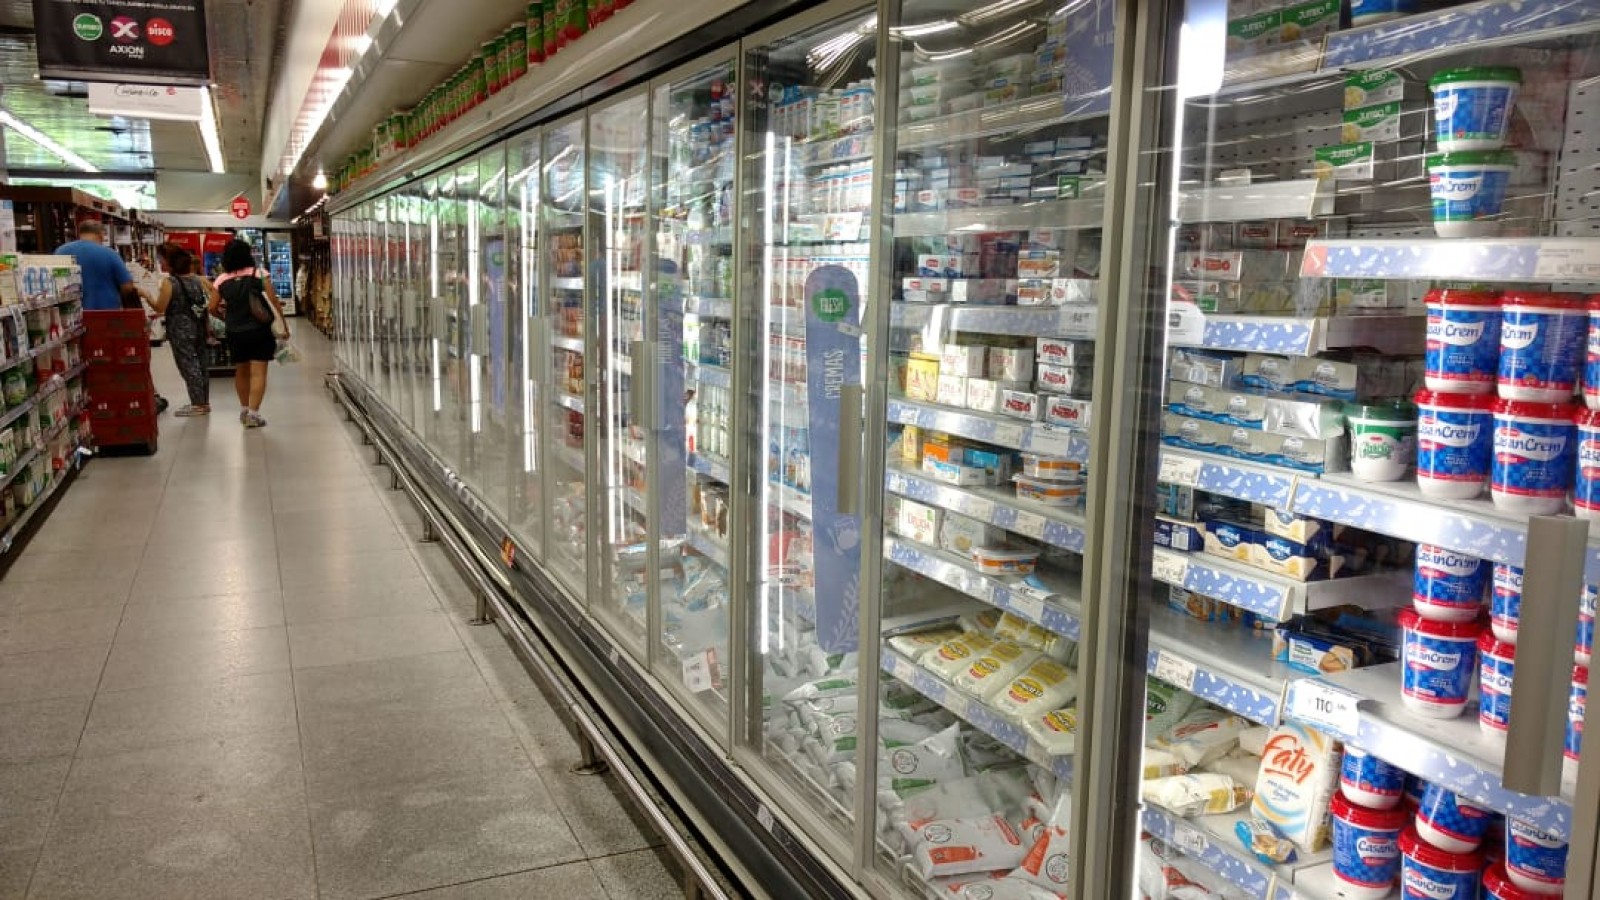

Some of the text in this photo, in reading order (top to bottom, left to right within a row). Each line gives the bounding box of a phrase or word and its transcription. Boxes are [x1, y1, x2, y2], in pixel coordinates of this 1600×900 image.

[109, 45, 144, 54] AXION
[820, 296, 843, 313] FRESH
[1260, 734, 1315, 784] Faty
